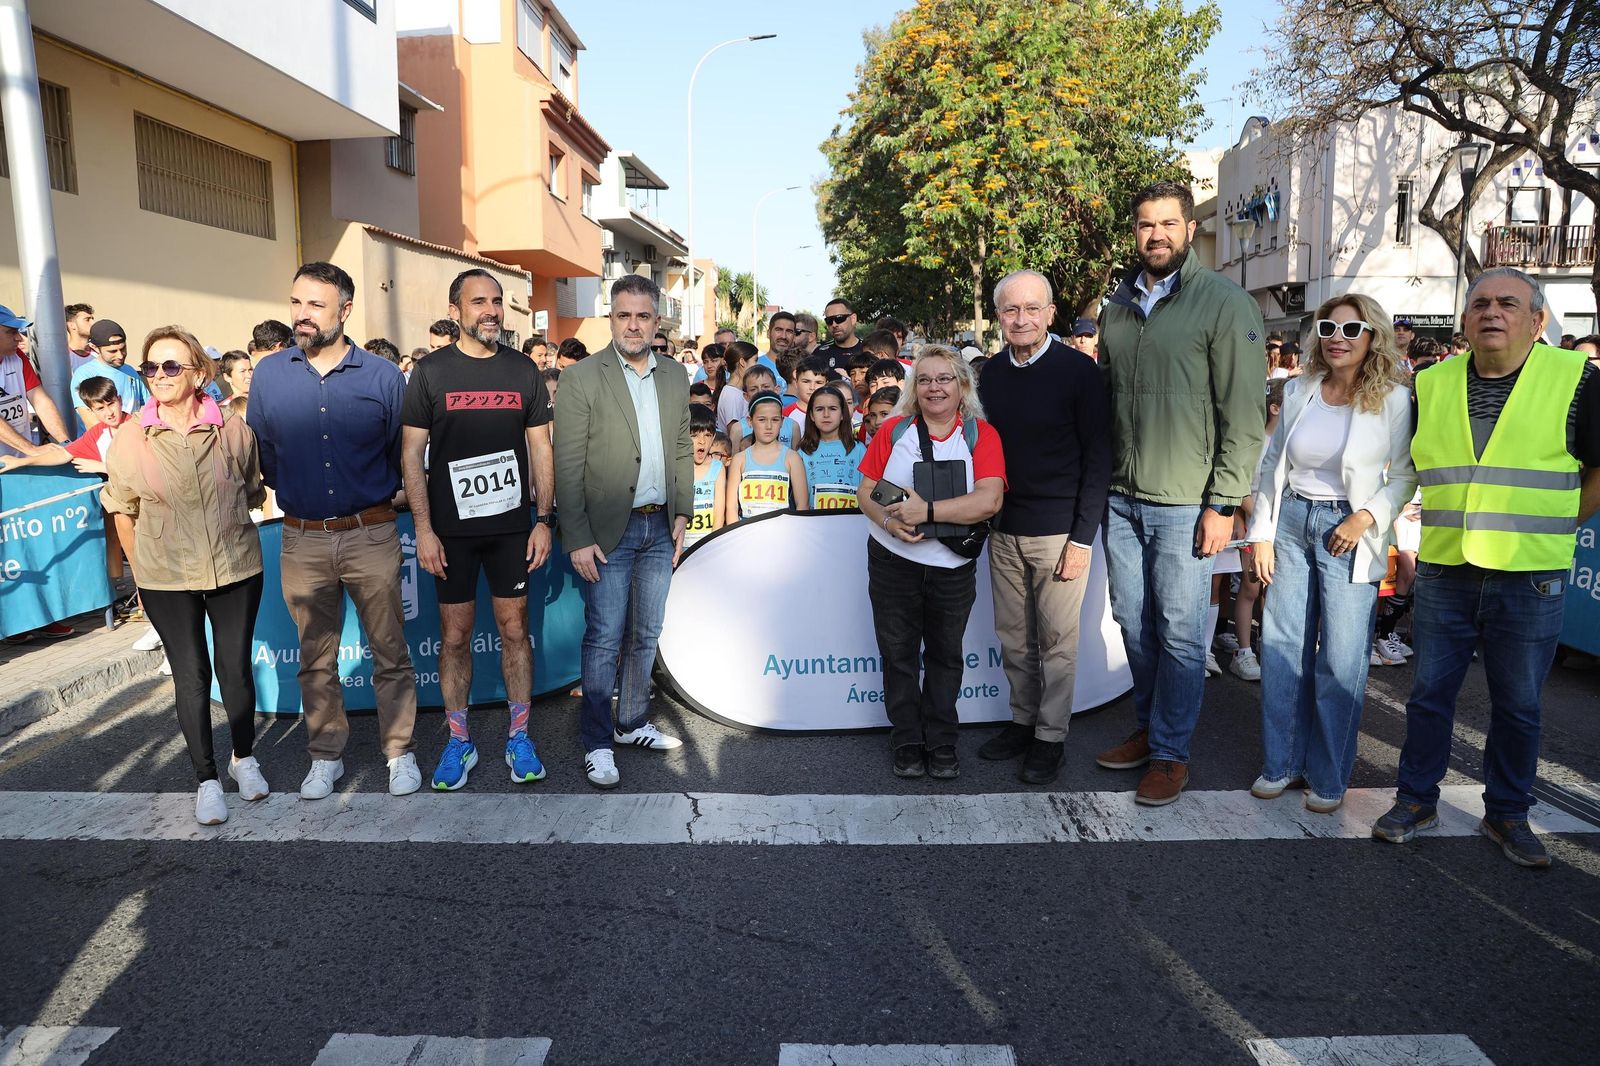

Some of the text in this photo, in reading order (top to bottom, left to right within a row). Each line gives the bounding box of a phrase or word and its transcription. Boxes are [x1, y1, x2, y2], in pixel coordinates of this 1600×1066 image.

[450, 394, 519, 406] アシックス
[1, 404, 24, 421] 229
[458, 468, 517, 498] 2014
[743, 484, 785, 501] 1141
